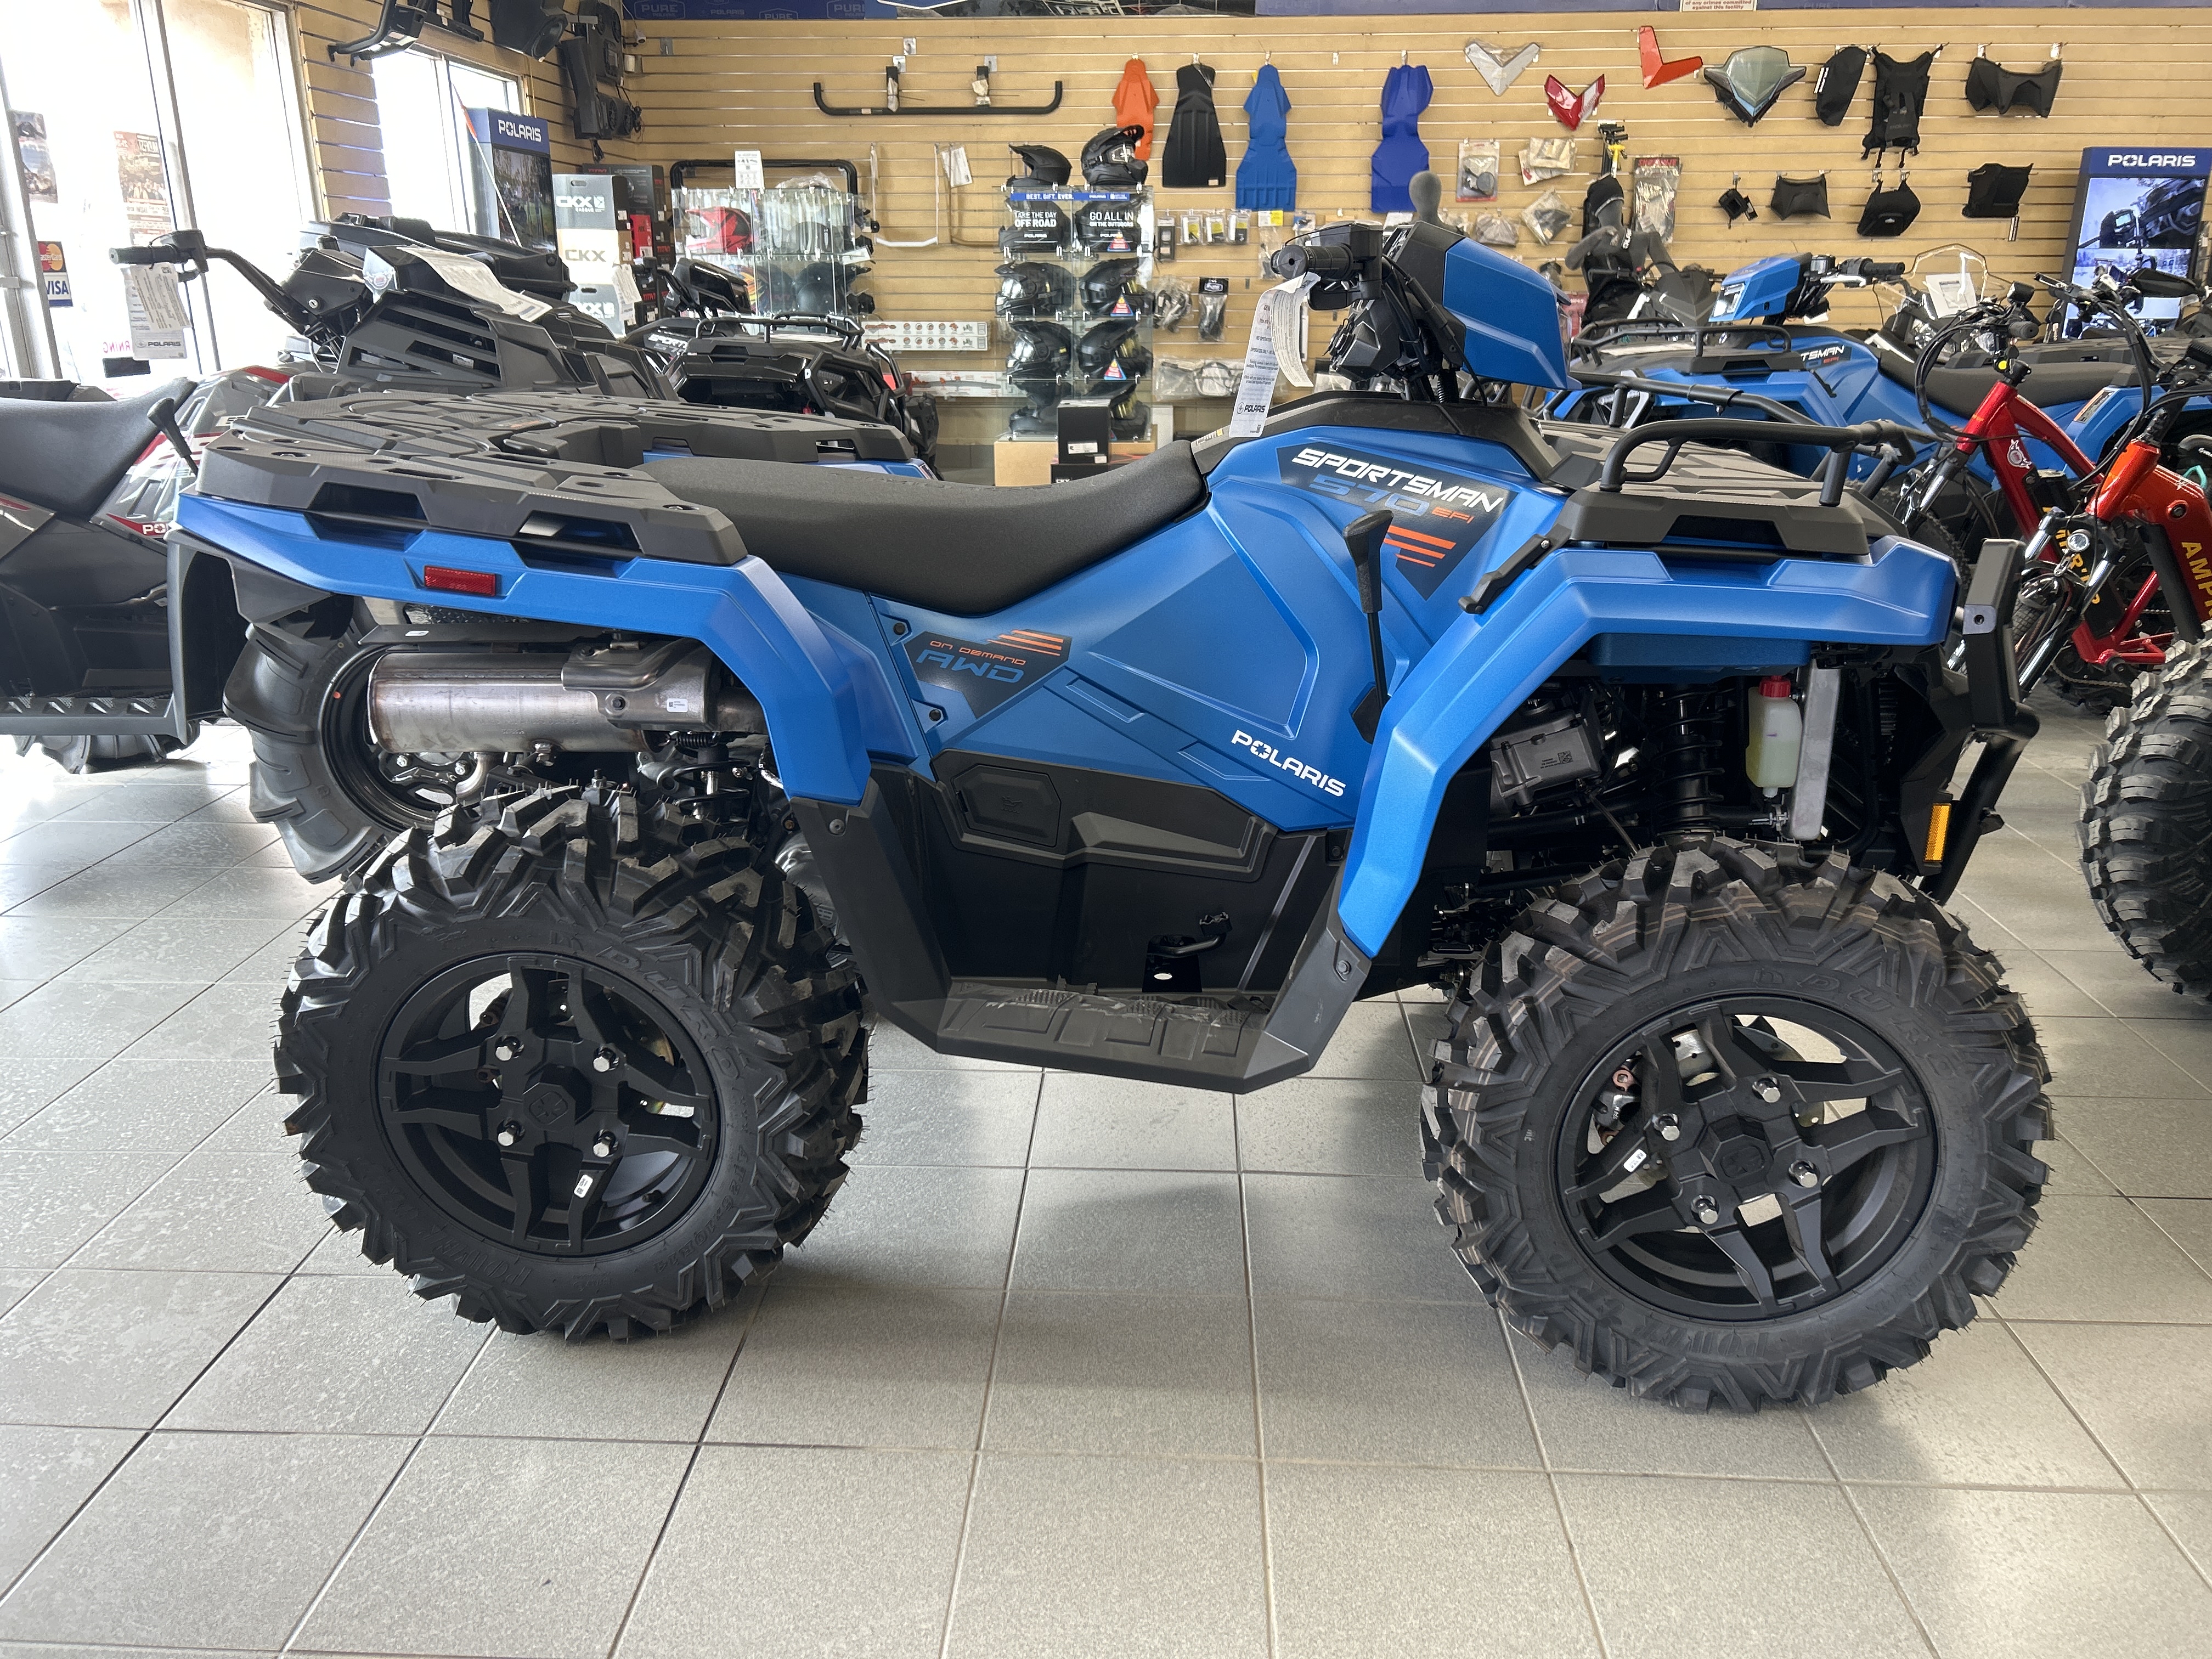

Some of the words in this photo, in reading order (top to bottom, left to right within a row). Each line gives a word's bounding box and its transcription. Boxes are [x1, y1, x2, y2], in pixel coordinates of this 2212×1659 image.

[641, 4, 678, 13] PURE
[834, 4, 865, 12] PUR
[498, 119, 541, 142] POLARIS
[2108, 154, 2196, 167] POLARIS
[556, 195, 593, 208] CKX
[1014, 219, 1031, 228] OFF
[1032, 219, 1057, 228] ROAD
[1089, 212, 1102, 221] GO
[1104, 212, 1122, 221] ALL
[1124, 212, 1134, 221] IN
[565, 249, 606, 262] CKX
[47, 280, 69, 295] VISA
[648, 334, 686, 348] SPORT
[1801, 345, 1844, 362] TSMAN
[1244, 404, 1266, 413] POLARIS
[1291, 448, 1504, 513] SPORTSMAN
[1308, 473, 1430, 516] 570
[1431, 506, 1475, 524] EFI
[929, 640, 953, 650] ON
[959, 647, 1026, 666] DEMAND
[916, 649, 1024, 684] AWD
[1231, 730, 1347, 797] POLARIS
[596, 946, 741, 1080] DURO
